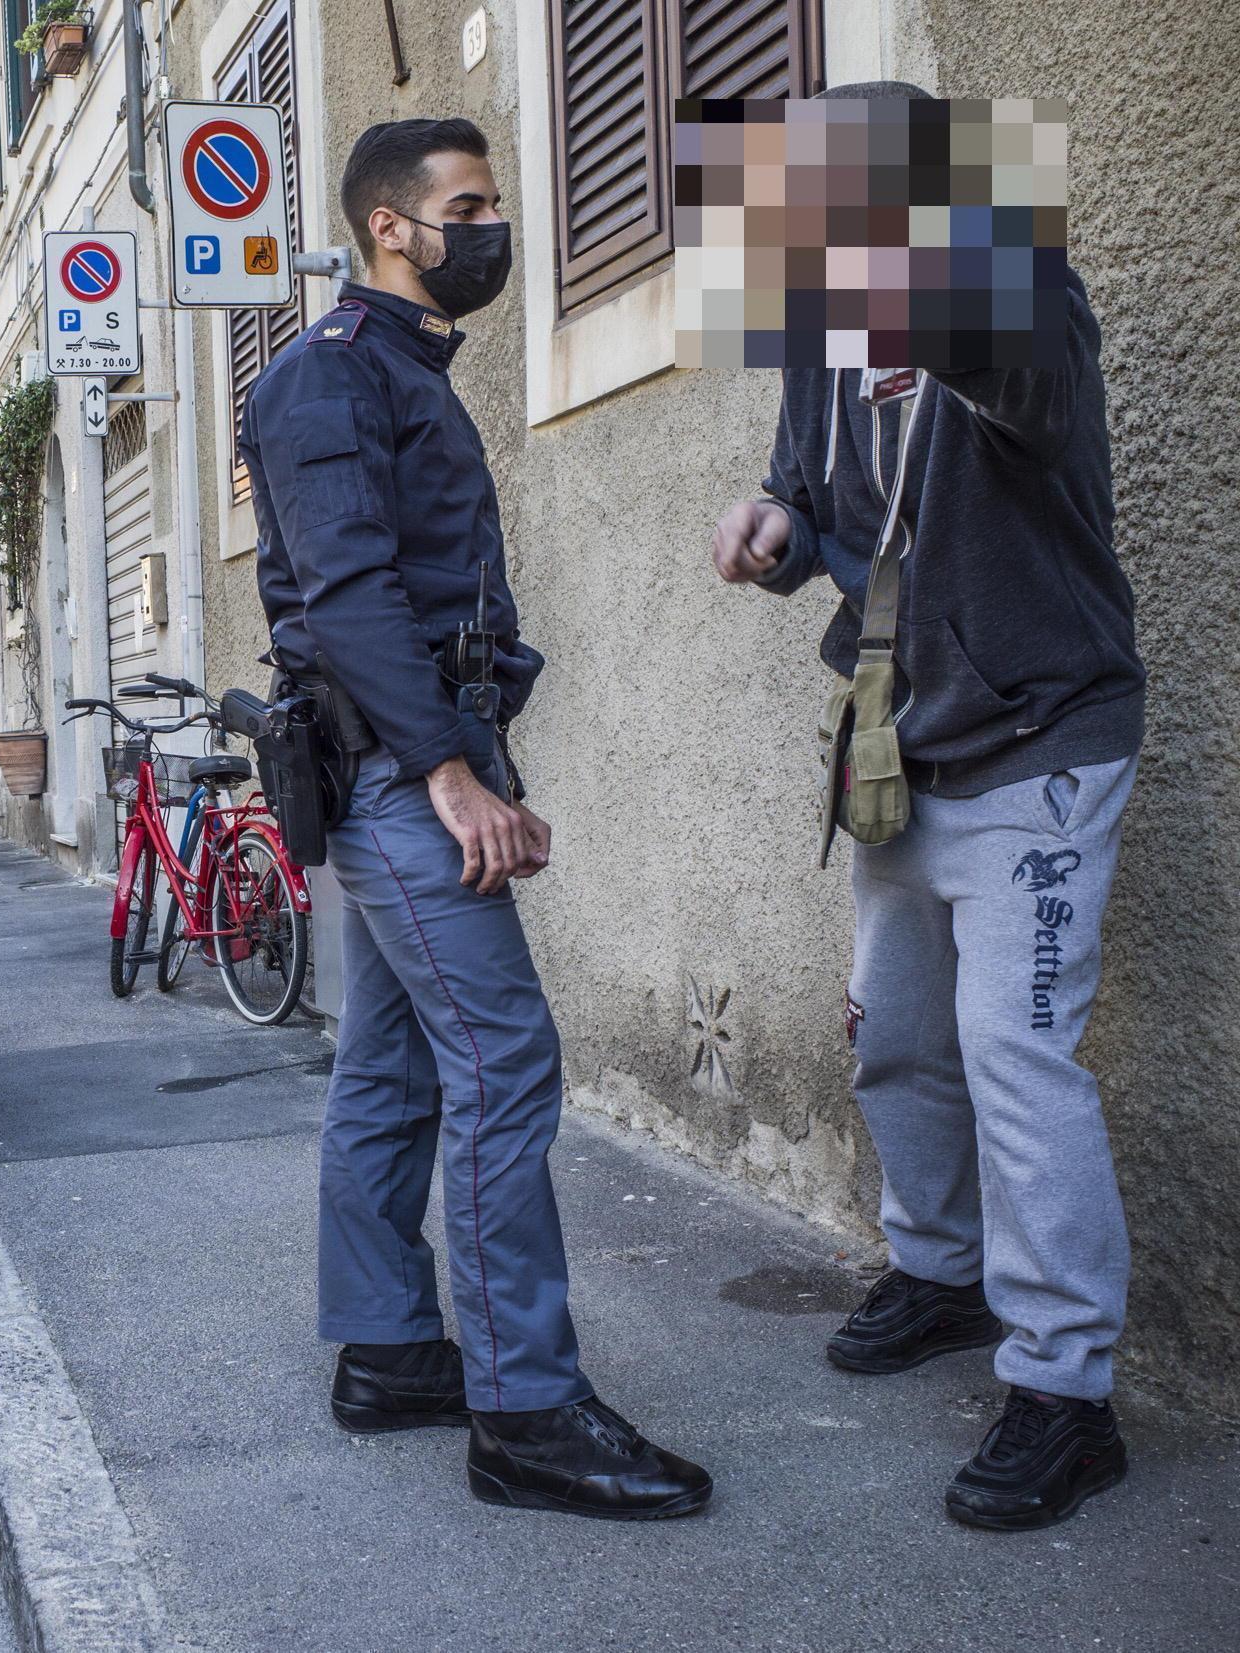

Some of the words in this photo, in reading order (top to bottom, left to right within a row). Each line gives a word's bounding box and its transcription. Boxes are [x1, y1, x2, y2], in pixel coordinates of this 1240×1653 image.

[193, 239, 215, 270] P
[63, 312, 77, 330] P
[106, 311, 120, 329] S
[70, 358, 91, 368] 7.30
[102, 357, 131, 368] 20.00
